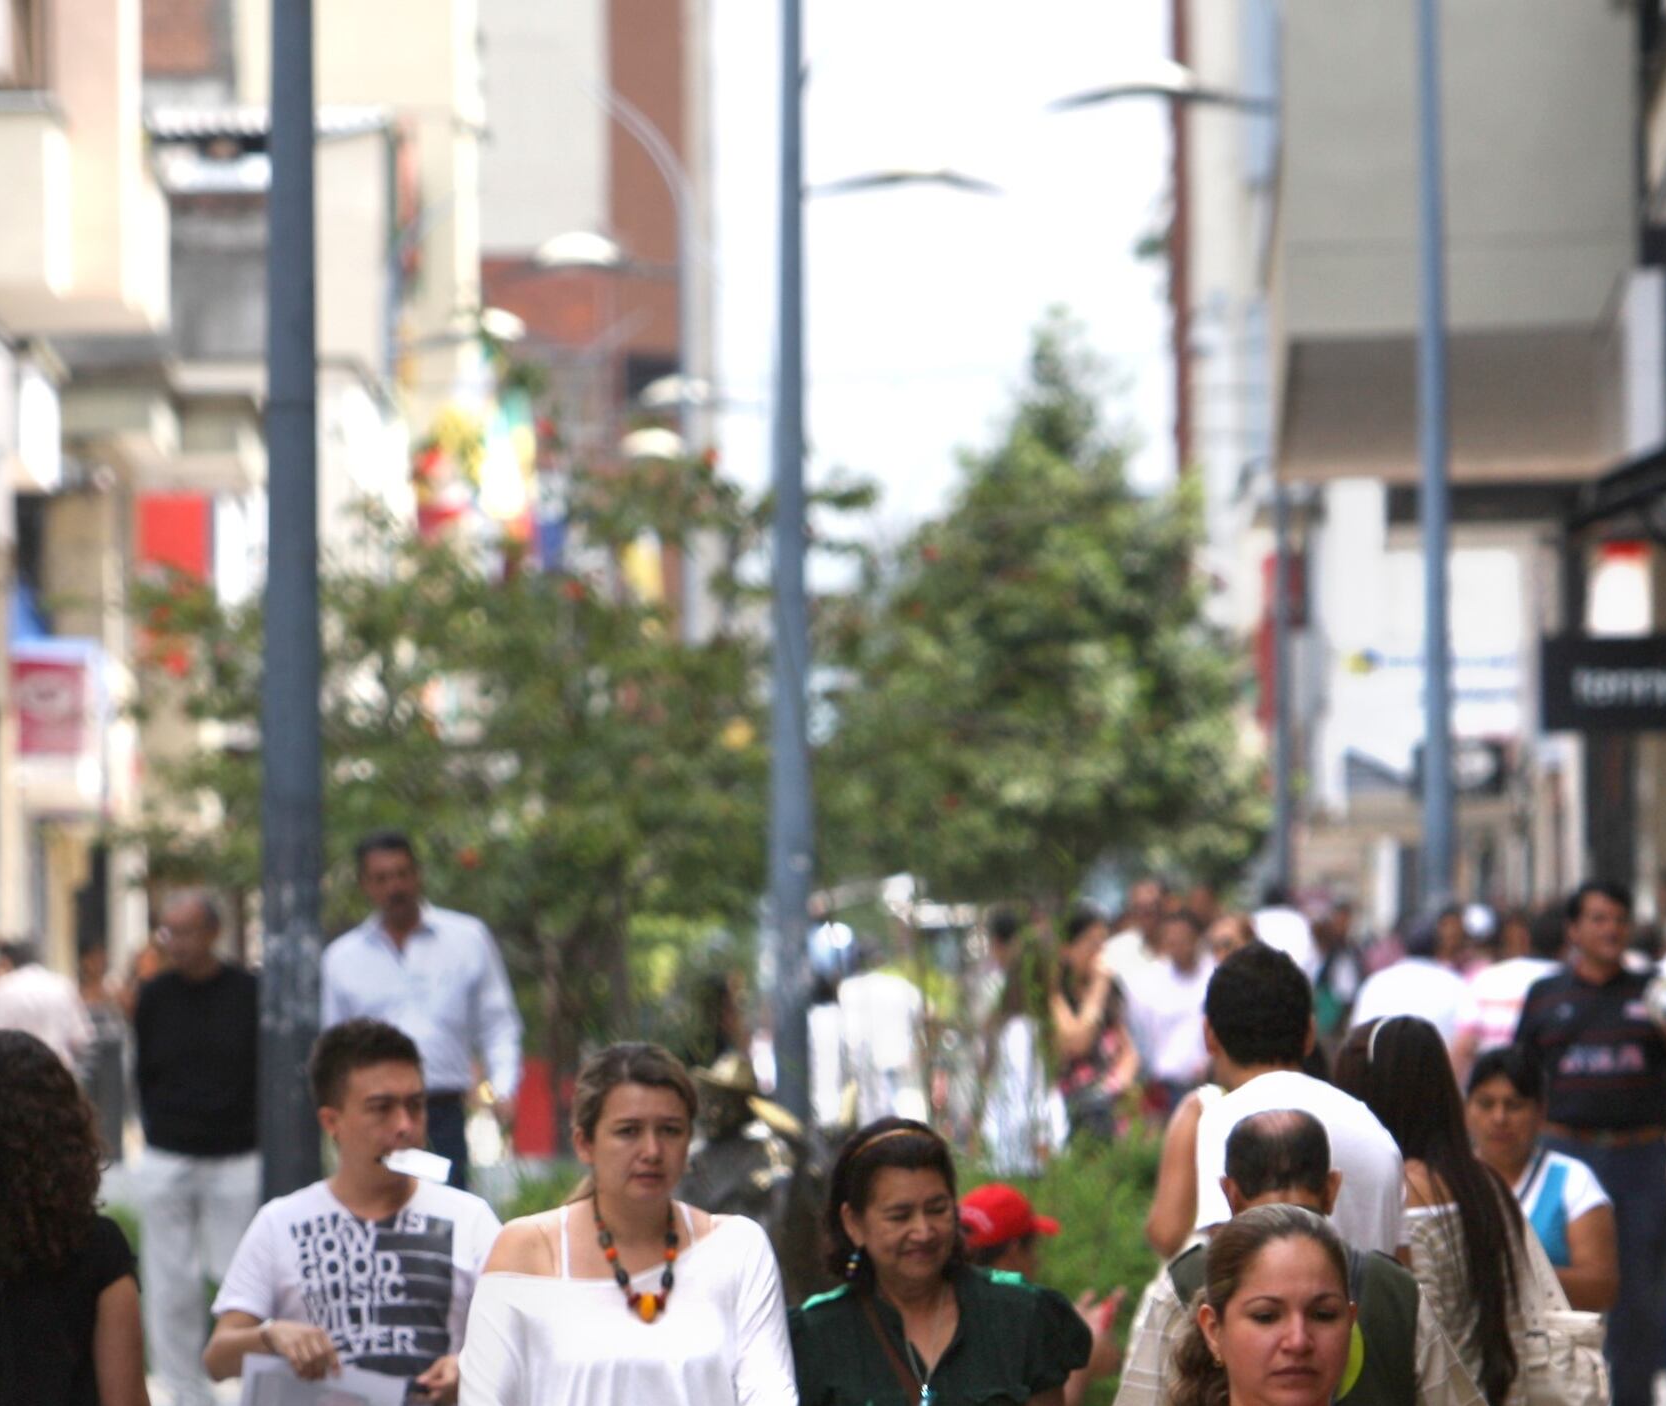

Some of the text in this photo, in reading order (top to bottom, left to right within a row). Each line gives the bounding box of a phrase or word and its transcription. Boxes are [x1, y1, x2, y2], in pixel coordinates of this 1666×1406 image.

[295, 1232, 377, 1263] HOW
[297, 1251, 401, 1283] GOOD
[299, 1275, 408, 1305] MUSIC
